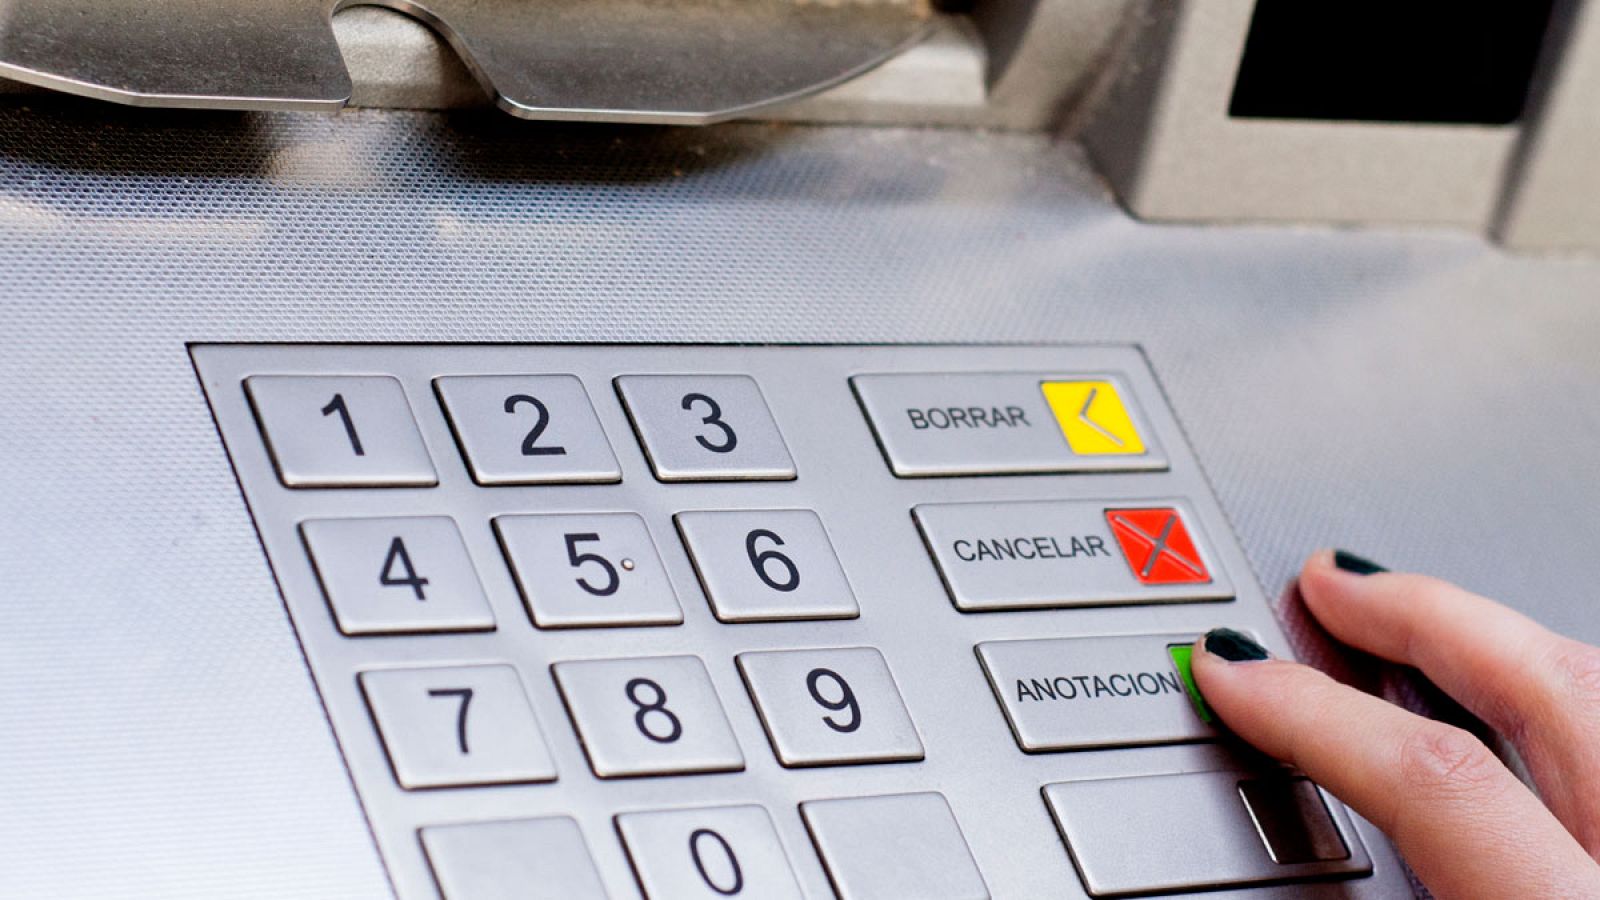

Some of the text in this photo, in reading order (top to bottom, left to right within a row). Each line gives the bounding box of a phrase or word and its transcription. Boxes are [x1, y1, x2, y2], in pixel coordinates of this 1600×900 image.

[321, 394, 365, 456] 1
[503, 394, 567, 456] 2
[684, 393, 737, 453] 3
[907, 406, 1031, 430] BORRAR
[380, 536, 429, 600] 4
[564, 532, 620, 597] 5
[745, 528, 800, 592] 6
[954, 535, 1110, 562] CANCELAR
[625, 678, 682, 744] 8
[806, 668, 861, 733] 9
[1016, 671, 1182, 703] ANOTACION
[428, 688, 473, 754] 7
[689, 828, 743, 896] 0
